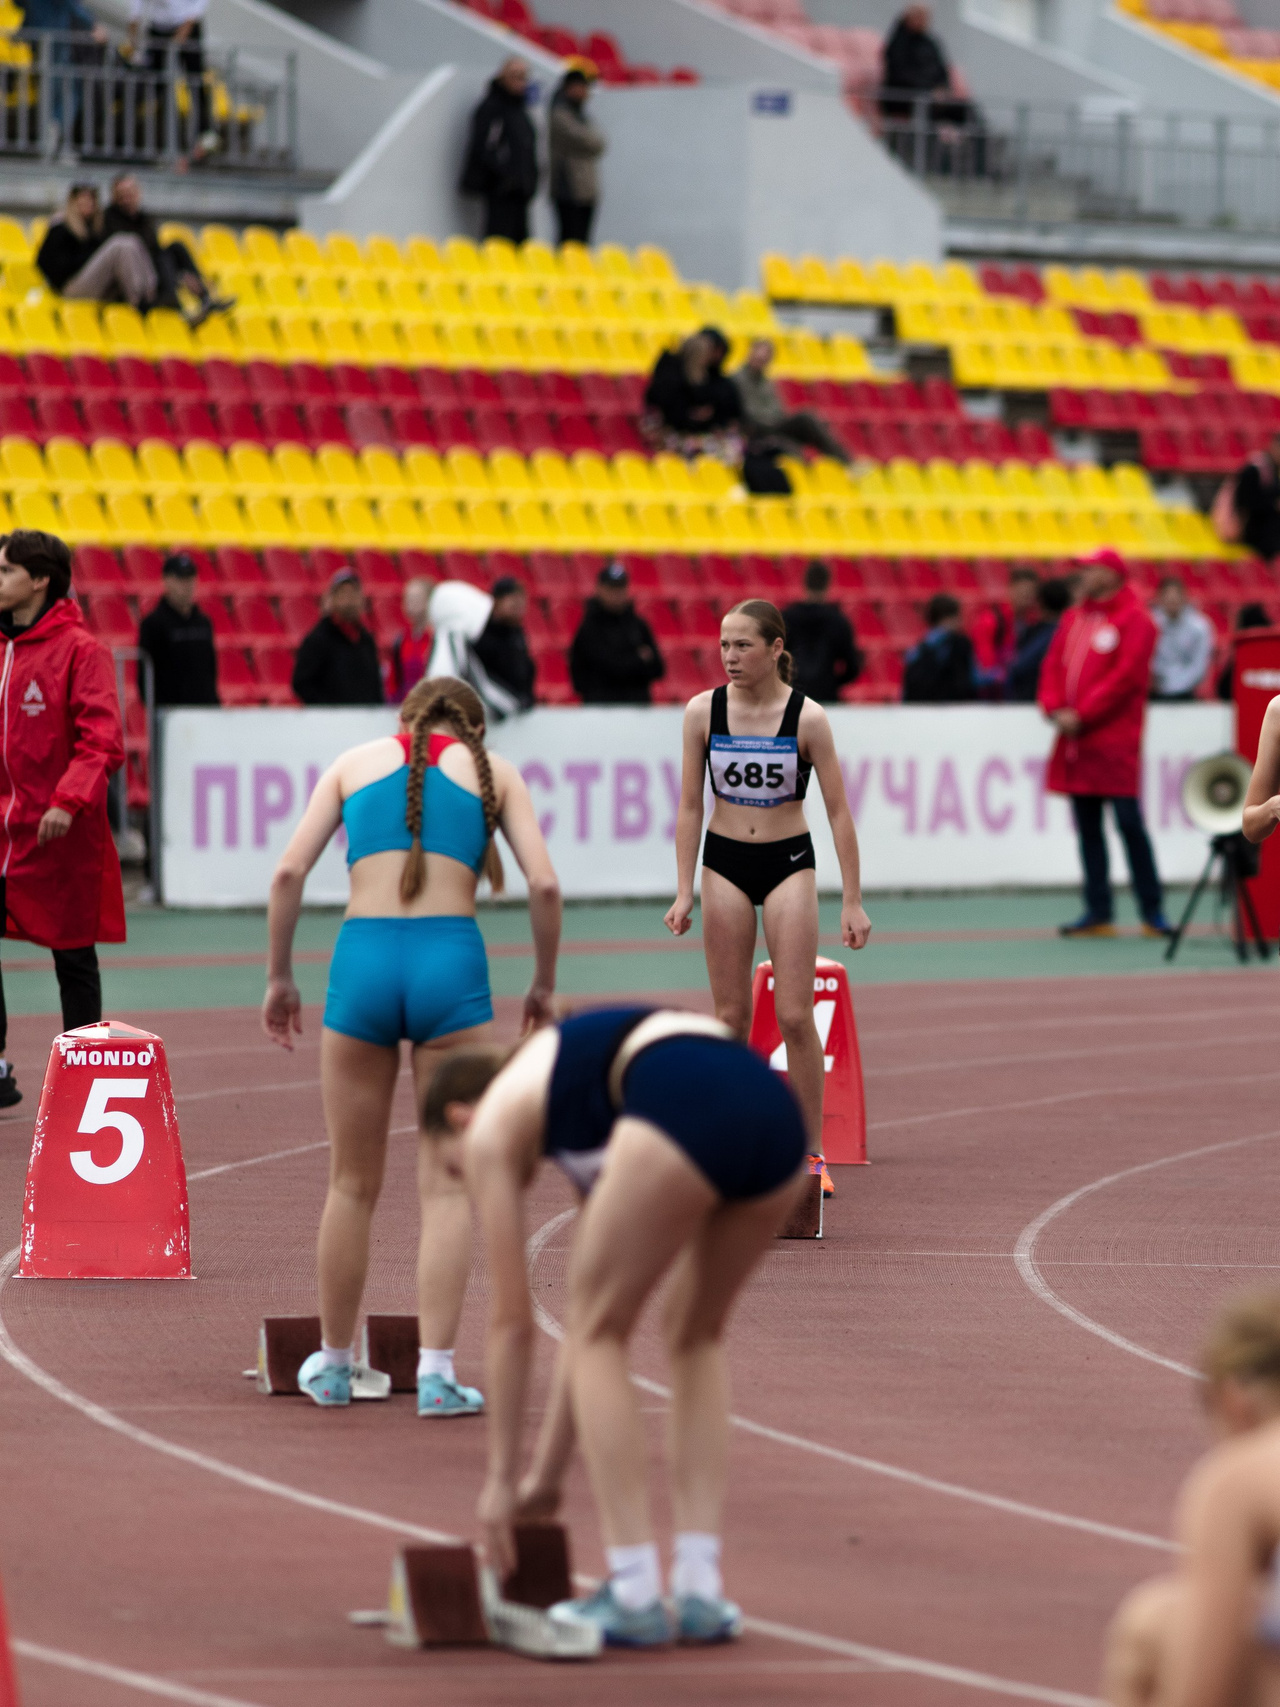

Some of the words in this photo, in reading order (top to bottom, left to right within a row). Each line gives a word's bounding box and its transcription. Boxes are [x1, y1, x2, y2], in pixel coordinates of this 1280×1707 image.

[723, 762, 785, 789] 685
[66, 1050, 152, 1066] MONDO
[69, 1078, 149, 1185] 5
